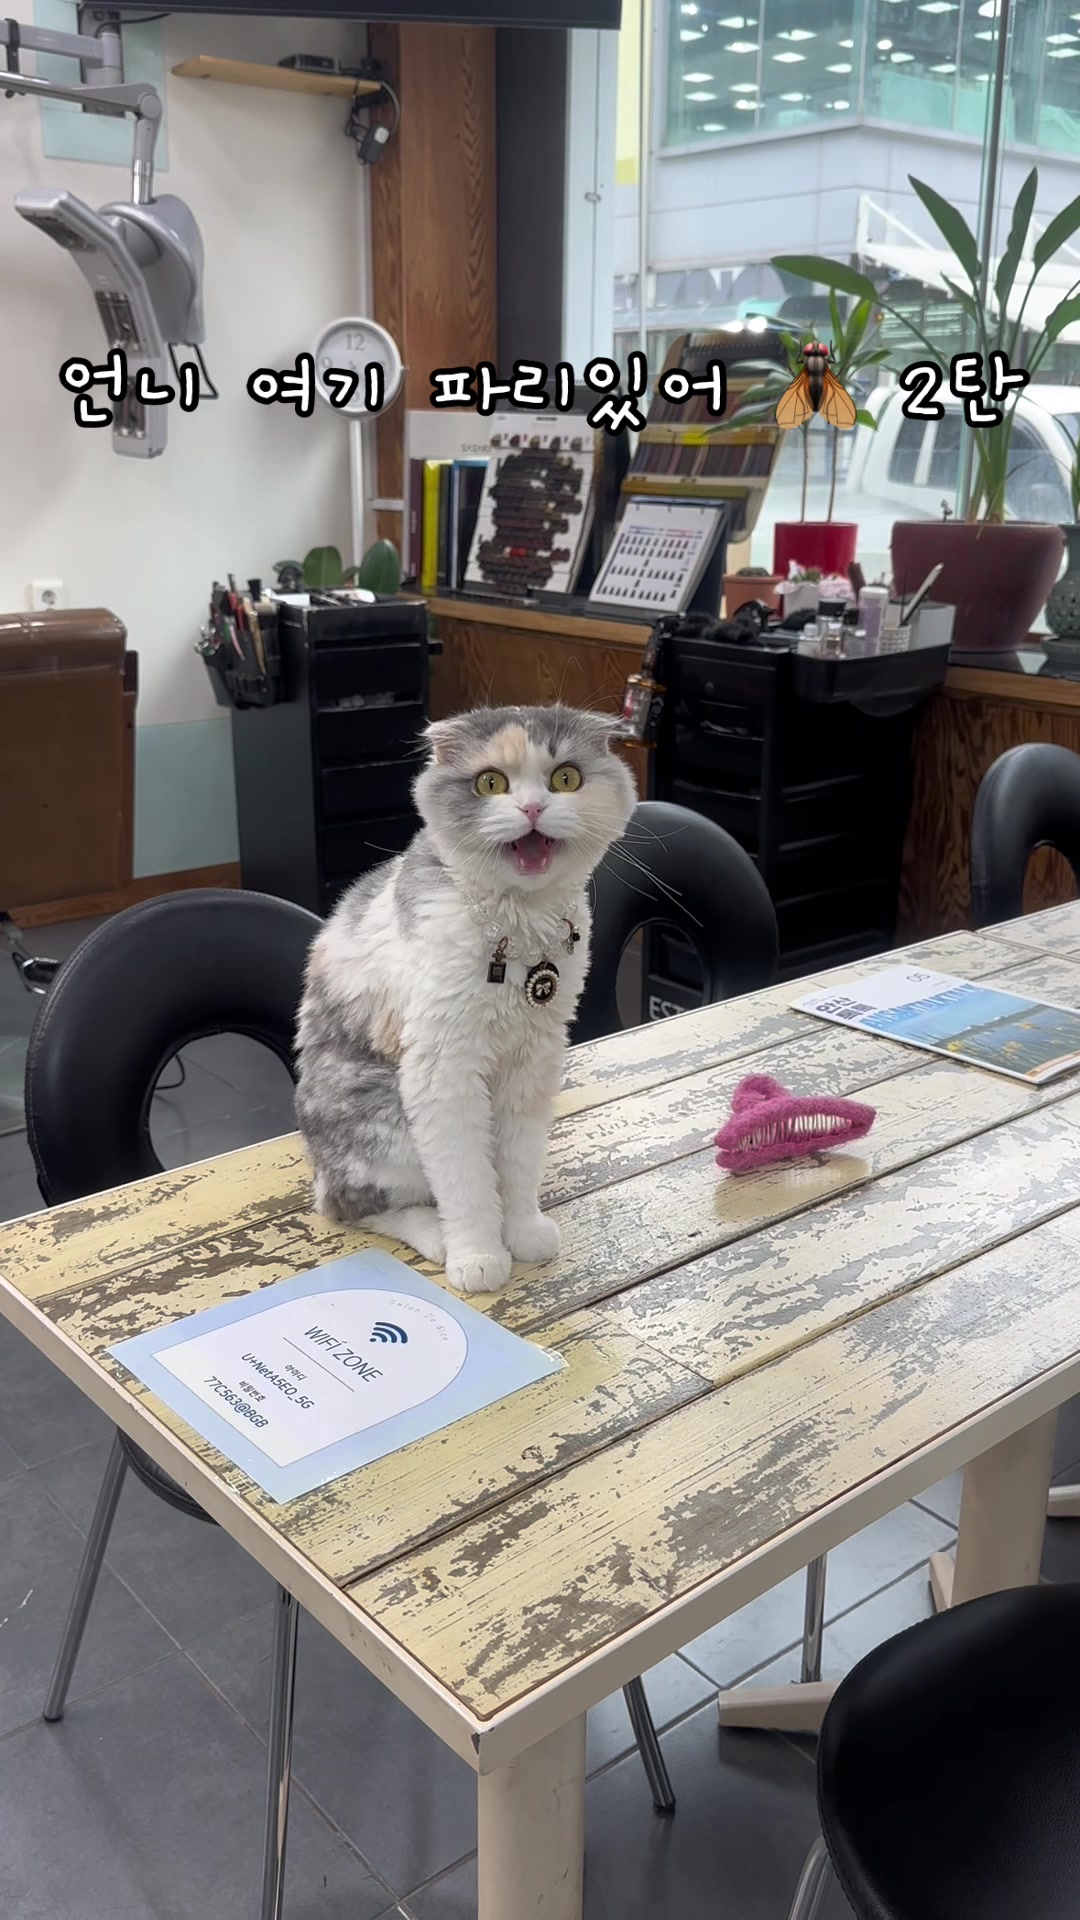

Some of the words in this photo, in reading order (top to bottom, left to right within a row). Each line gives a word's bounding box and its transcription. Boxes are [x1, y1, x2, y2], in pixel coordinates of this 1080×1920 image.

[345, 333, 365, 351] 12
[815, 996, 858, 1014] 안산
[284, 1363, 307, 1382] 아이디
[332, 1347, 384, 1383] ZONE
[238, 1379, 267, 1403] 비밀번호
